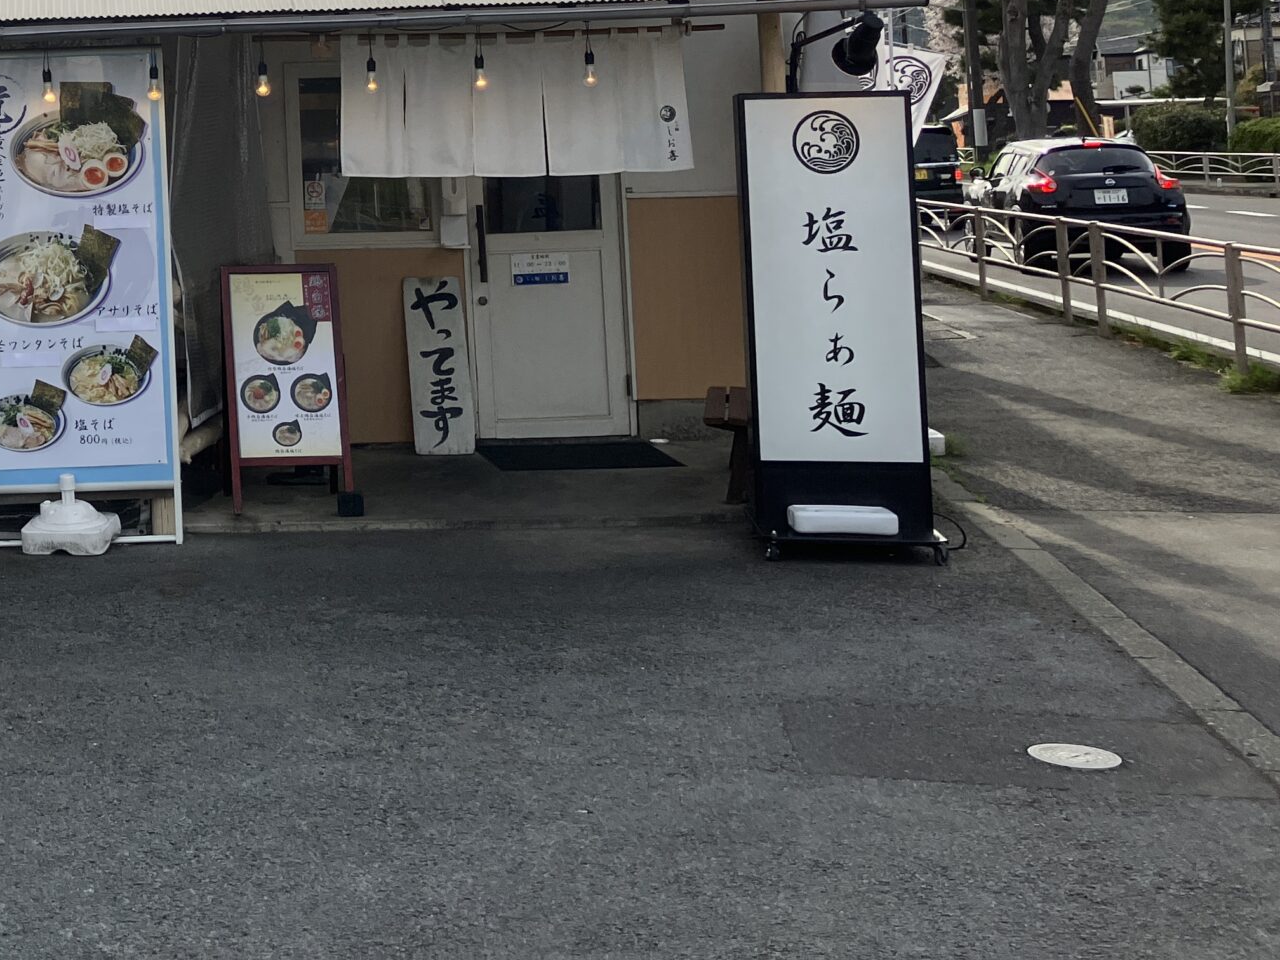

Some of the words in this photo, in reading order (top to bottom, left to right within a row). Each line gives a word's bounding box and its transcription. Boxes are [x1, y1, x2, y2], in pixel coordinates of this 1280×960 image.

[92, 202, 153, 216] 特製塩そば
[95, 302, 158, 317] アサリそば
[410, 280, 463, 448] やってます
[74, 416, 115, 431] 塩そば
